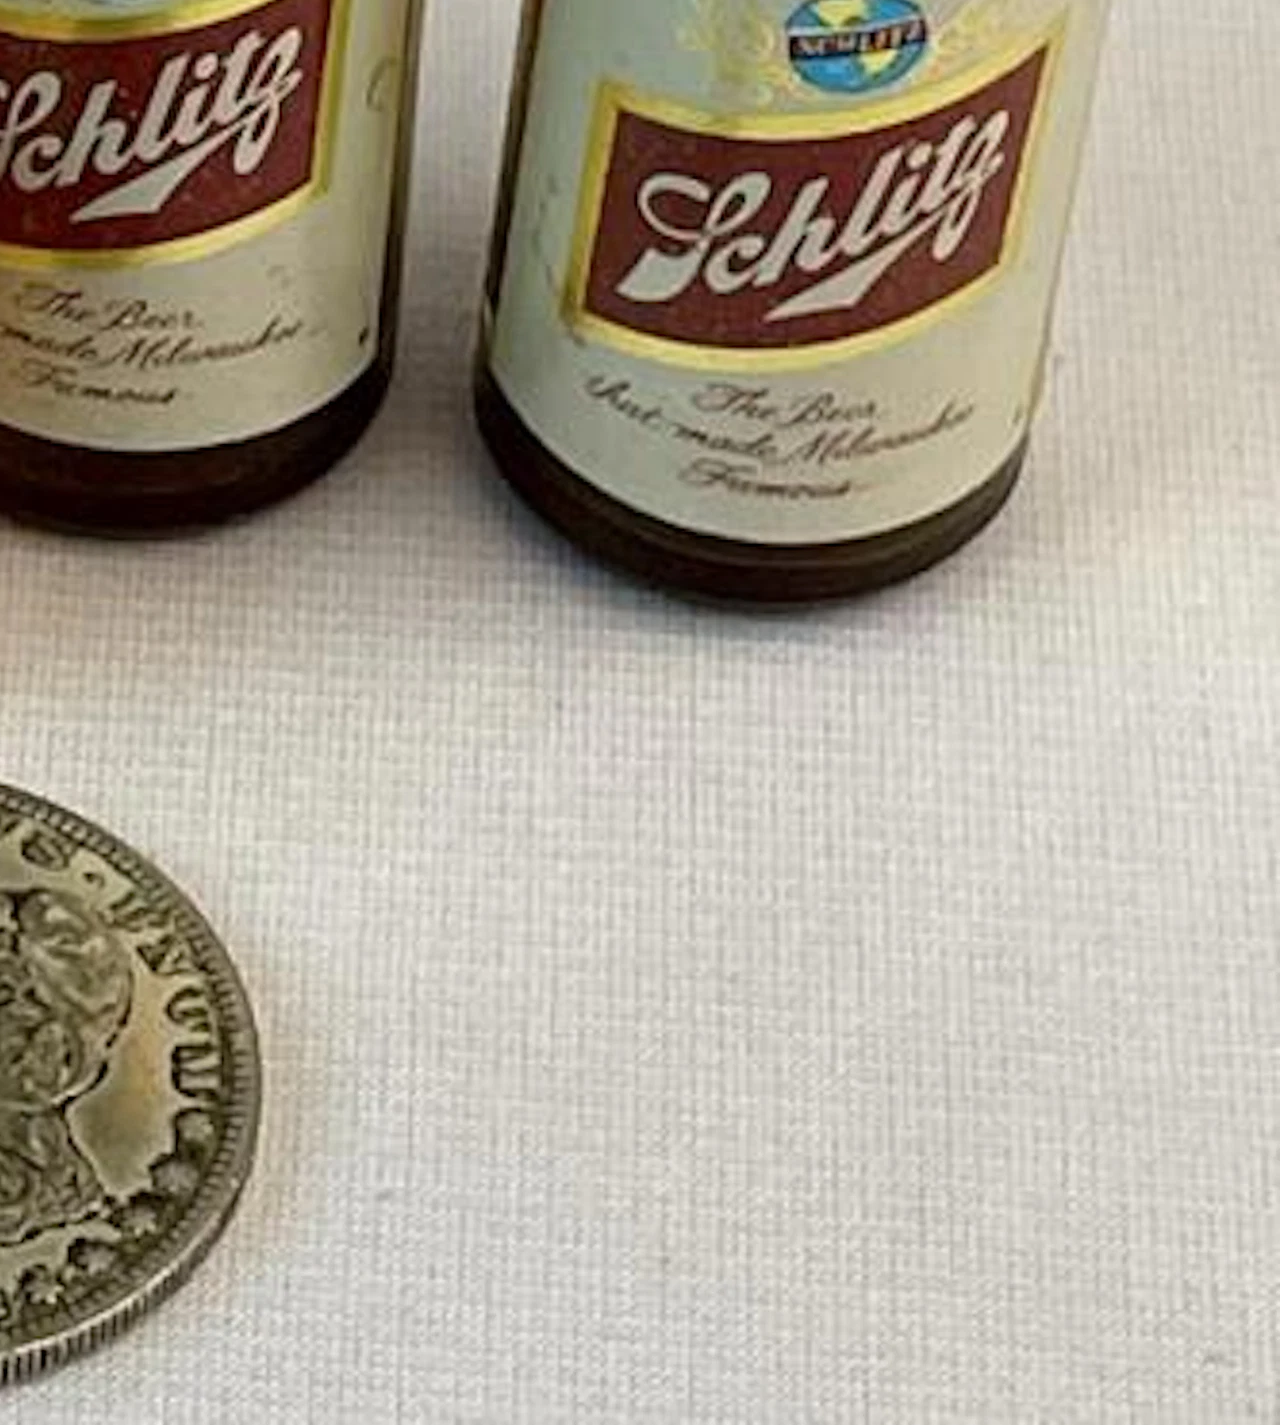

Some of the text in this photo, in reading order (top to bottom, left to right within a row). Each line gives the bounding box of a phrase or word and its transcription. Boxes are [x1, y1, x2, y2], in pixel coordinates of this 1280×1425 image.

[614, 109, 1010, 323] Schlitz
[16, 280, 98, 326] The
[691, 382, 776, 423] The
